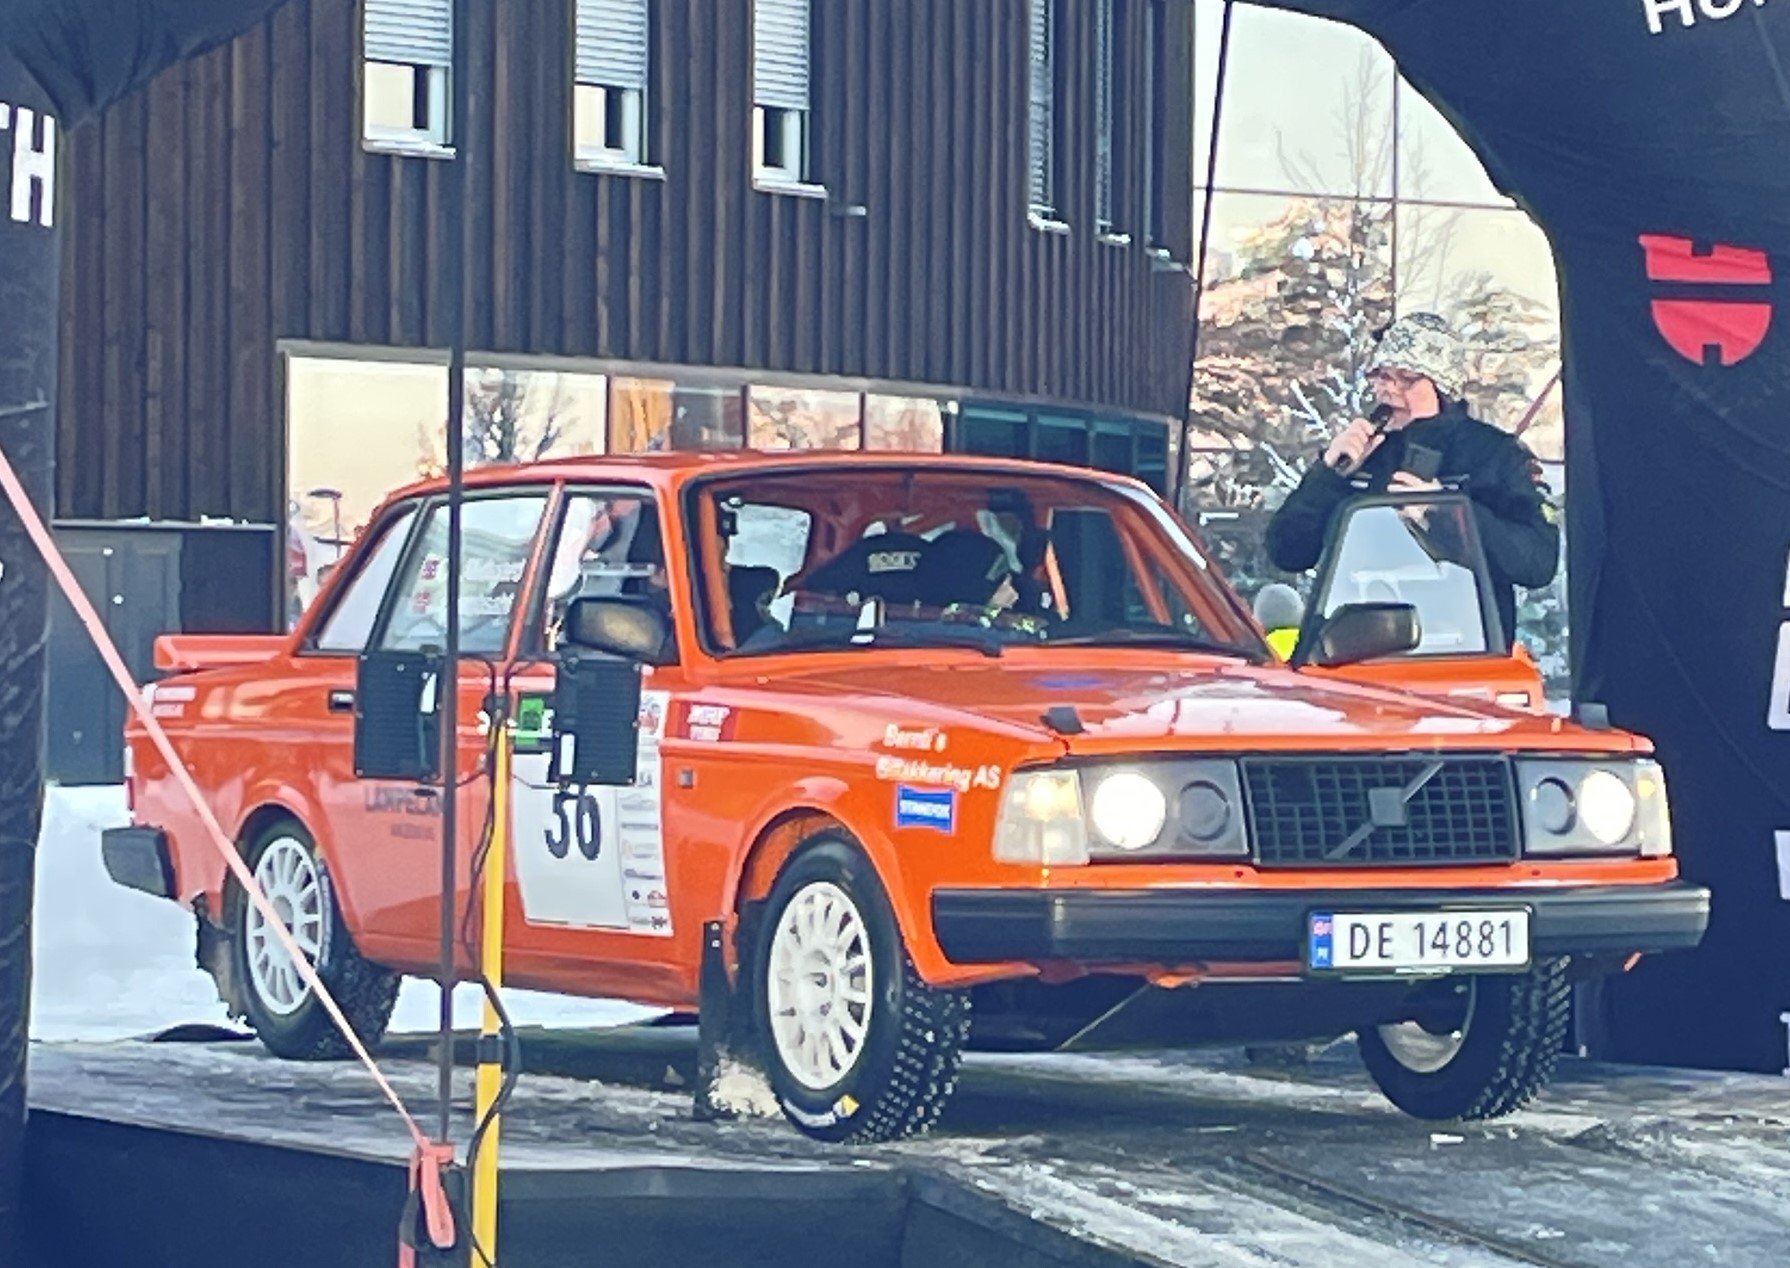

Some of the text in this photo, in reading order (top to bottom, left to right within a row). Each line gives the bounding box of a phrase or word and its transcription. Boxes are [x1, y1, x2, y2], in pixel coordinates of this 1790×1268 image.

[0, 102, 55, 228] H
[972, 764, 1001, 790] AS
[1349, 919, 1512, 960] DE 14881
